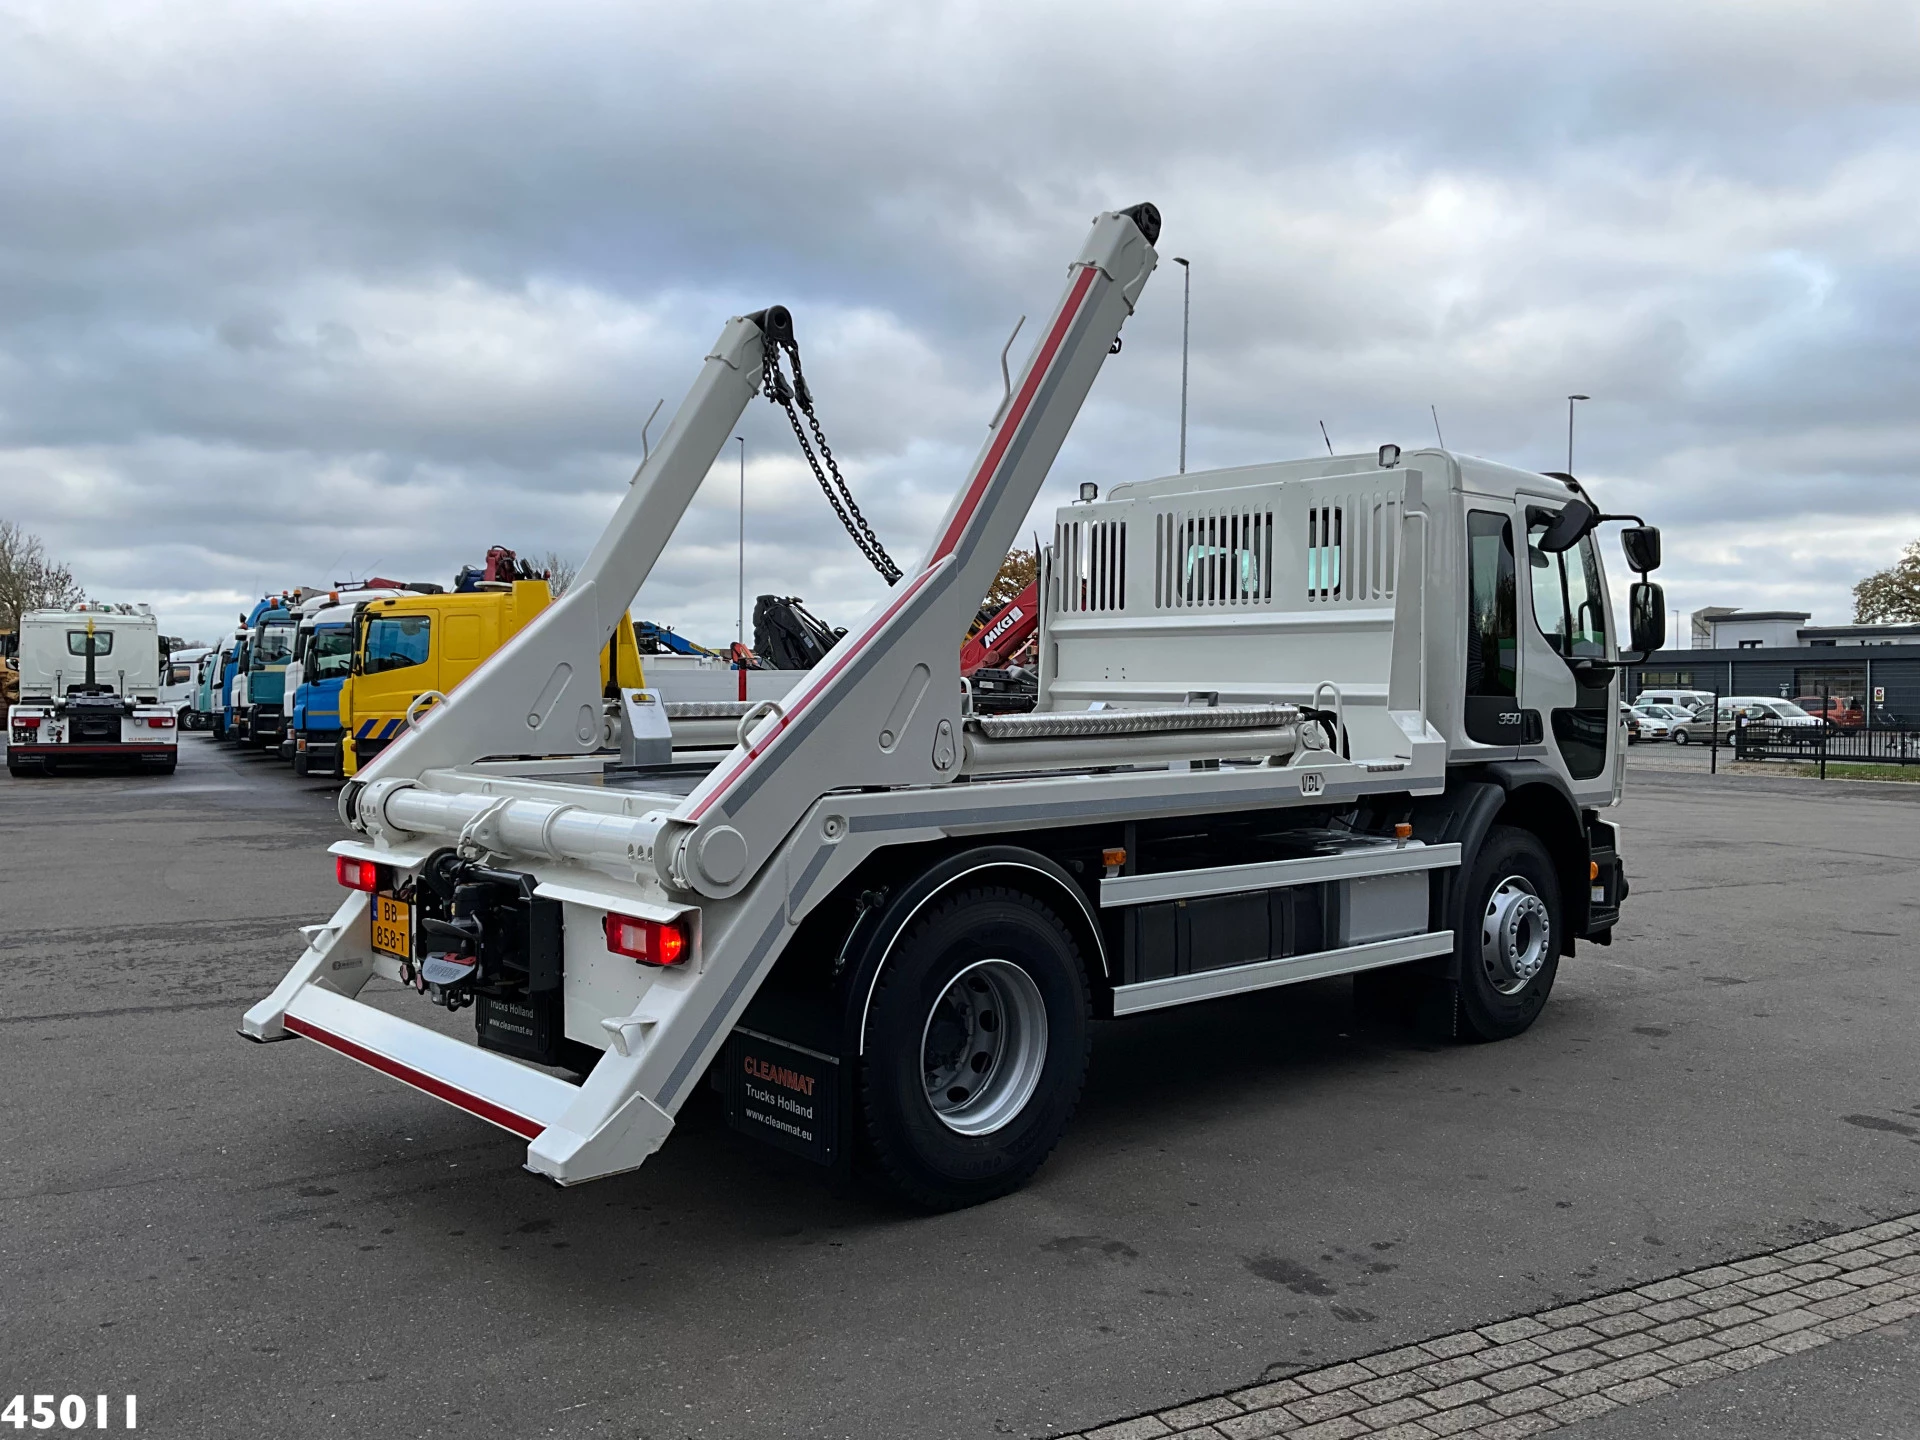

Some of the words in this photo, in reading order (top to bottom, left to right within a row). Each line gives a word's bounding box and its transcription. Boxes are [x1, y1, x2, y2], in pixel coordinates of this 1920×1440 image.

[983, 615, 1014, 649] MKG
[1498, 712, 1521, 725] 350
[1301, 775, 1320, 793] VDL
[384, 902, 397, 923] BB
[376, 925, 405, 952] 858-T
[509, 1003, 534, 1019] Holland
[489, 1018, 534, 1037] www.cleanmat.eu
[743, 1055, 815, 1097] CLEANMAT
[745, 1083, 775, 1106] Trucks
[777, 1094, 814, 1120] Holland
[745, 1107, 813, 1142] www.cleanmat.eu
